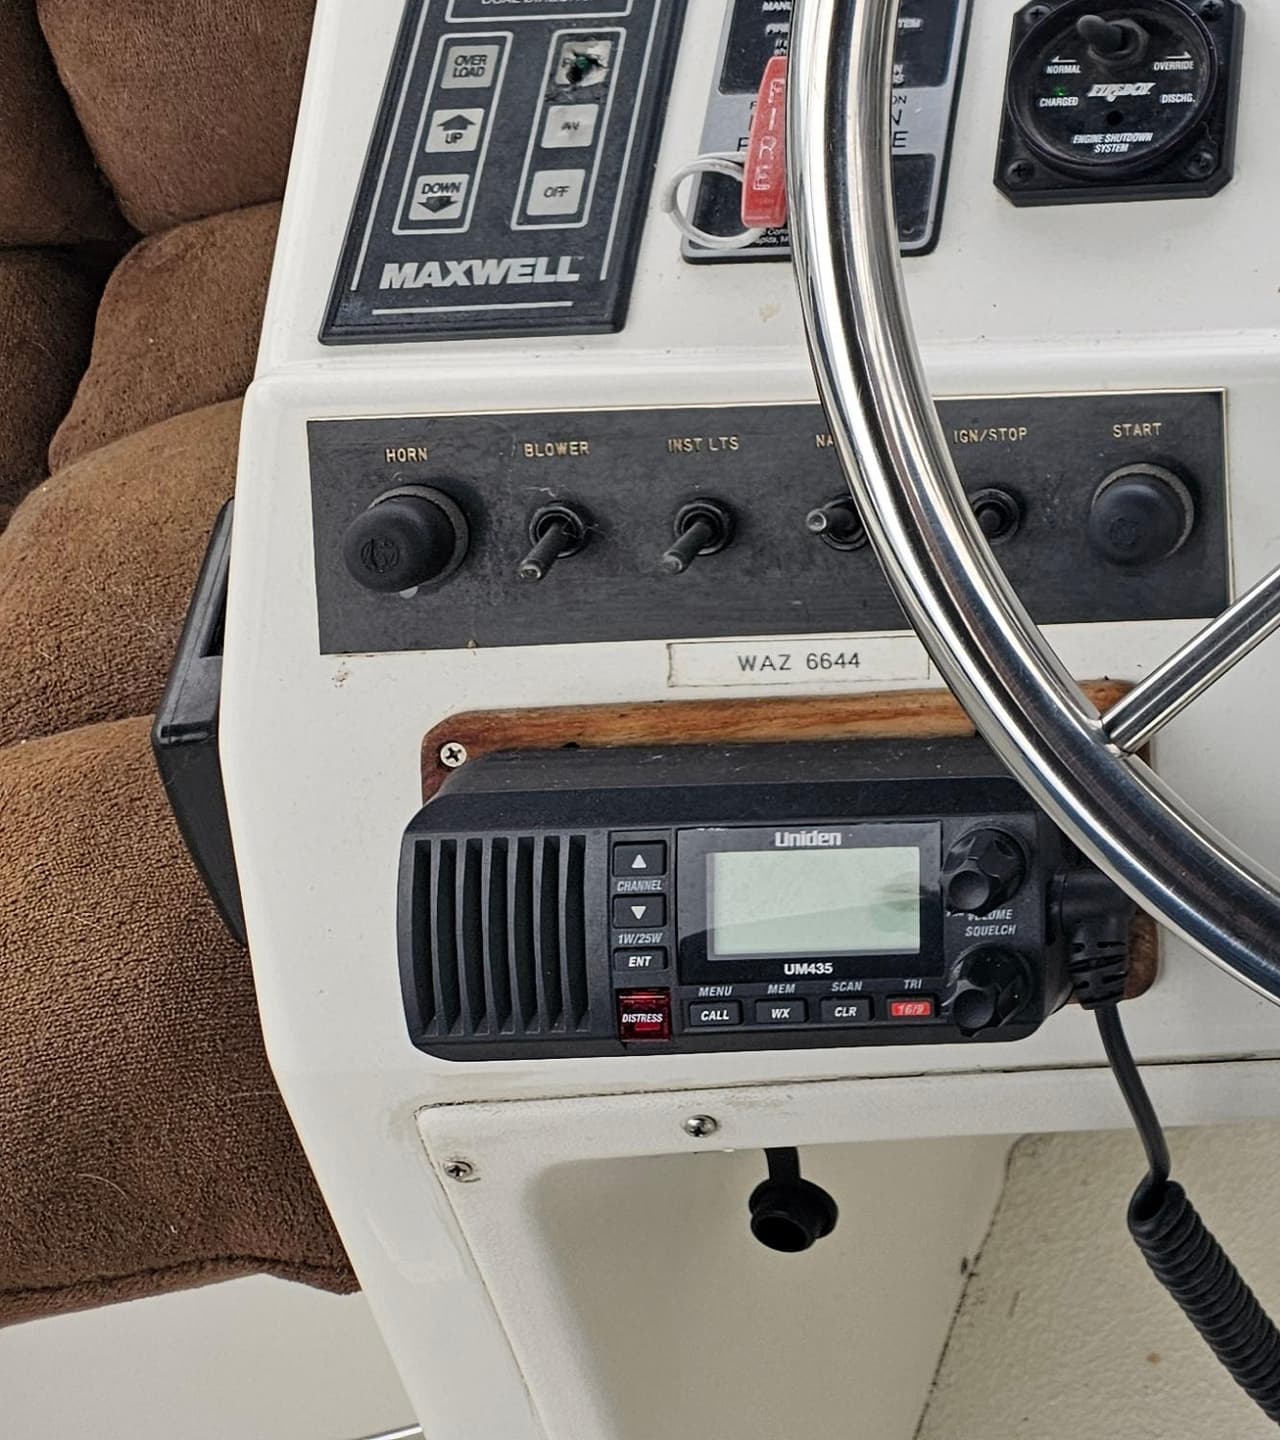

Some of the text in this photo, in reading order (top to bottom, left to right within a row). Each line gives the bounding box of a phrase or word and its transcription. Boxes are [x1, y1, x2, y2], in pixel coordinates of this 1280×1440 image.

[453, 53, 488, 67] OVER
[1153, 60, 1194, 72] OVERRIDE
[452, 66, 486, 79] LOAD
[1046, 64, 1082, 75] NORMAL
[1039, 96, 1079, 108] CHARGED
[1161, 92, 1196, 104] DISCHG.
[444, 131, 464, 145] UP
[752, 78, 786, 192] FIRE
[1072, 131, 1154, 144] ENGINE SHUTDOWN
[1094, 143, 1130, 153] SYSTEM
[421, 181, 462, 195] DOWN
[543, 185, 570, 199] OFF
[378, 256, 581, 290] MAXWELL
[953, 426, 1030, 444] IGN/STOP
[1112, 422, 1163, 438] START
[666, 434, 741, 454] INST LTS
[815, 433, 837, 448] NA
[385, 446, 429, 463] HORN
[524, 440, 592, 458] BLOWER
[737, 651, 862, 672] WAZ 6644
[775, 831, 842, 847] Uniden
[617, 879, 663, 893] CHANNEL
[964, 924, 1017, 937] SQUELCH
[617, 932, 664, 946] 1W/25W
[628, 955, 652, 968] ENT
[783, 962, 834, 976] UM435
[766, 983, 796, 995] MEM
[831, 981, 863, 993] SCAN
[903, 978, 923, 991] TRI
[698, 985, 734, 998] MENU
[621, 1012, 664, 1024] DISTRESS
[700, 1009, 731, 1022] CALL
[770, 1008, 792, 1020] WX
[833, 1005, 858, 1018] CLR
